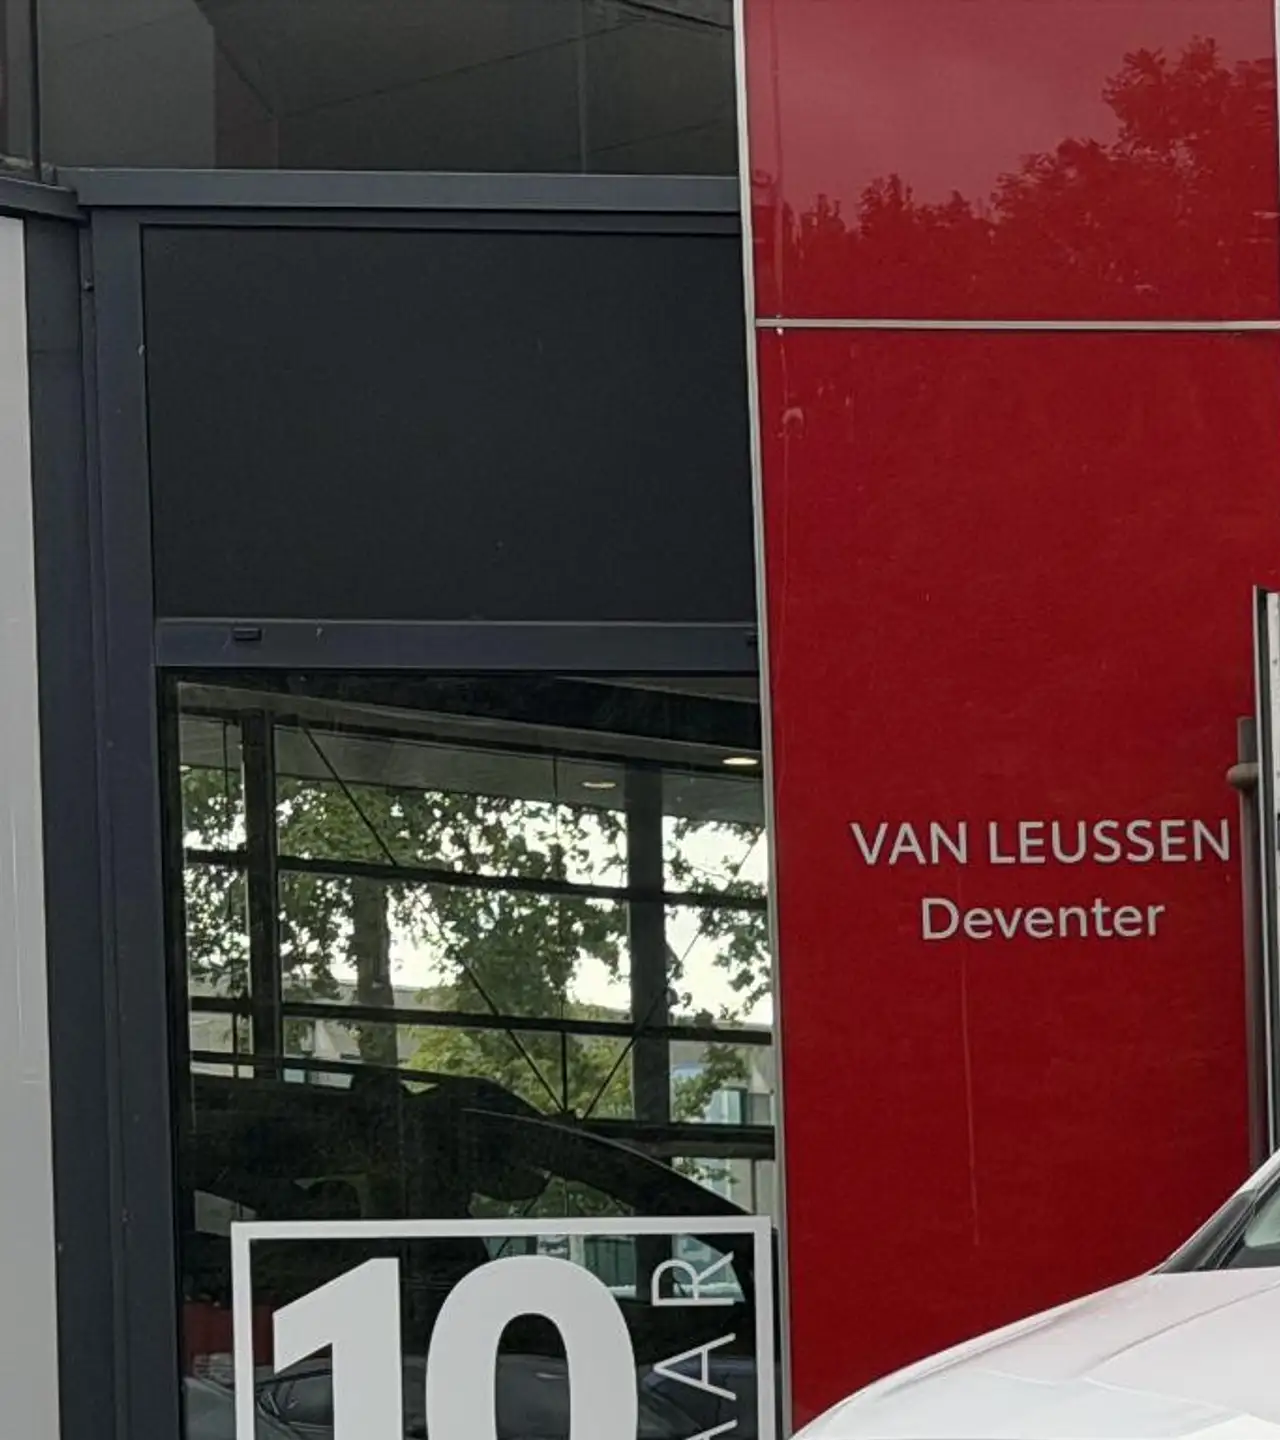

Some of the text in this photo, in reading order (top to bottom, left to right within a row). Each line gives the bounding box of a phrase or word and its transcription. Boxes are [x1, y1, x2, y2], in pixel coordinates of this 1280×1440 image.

[851, 819, 1231, 865] VAN LEUSSEN
[921, 897, 1165, 940] Deventer
